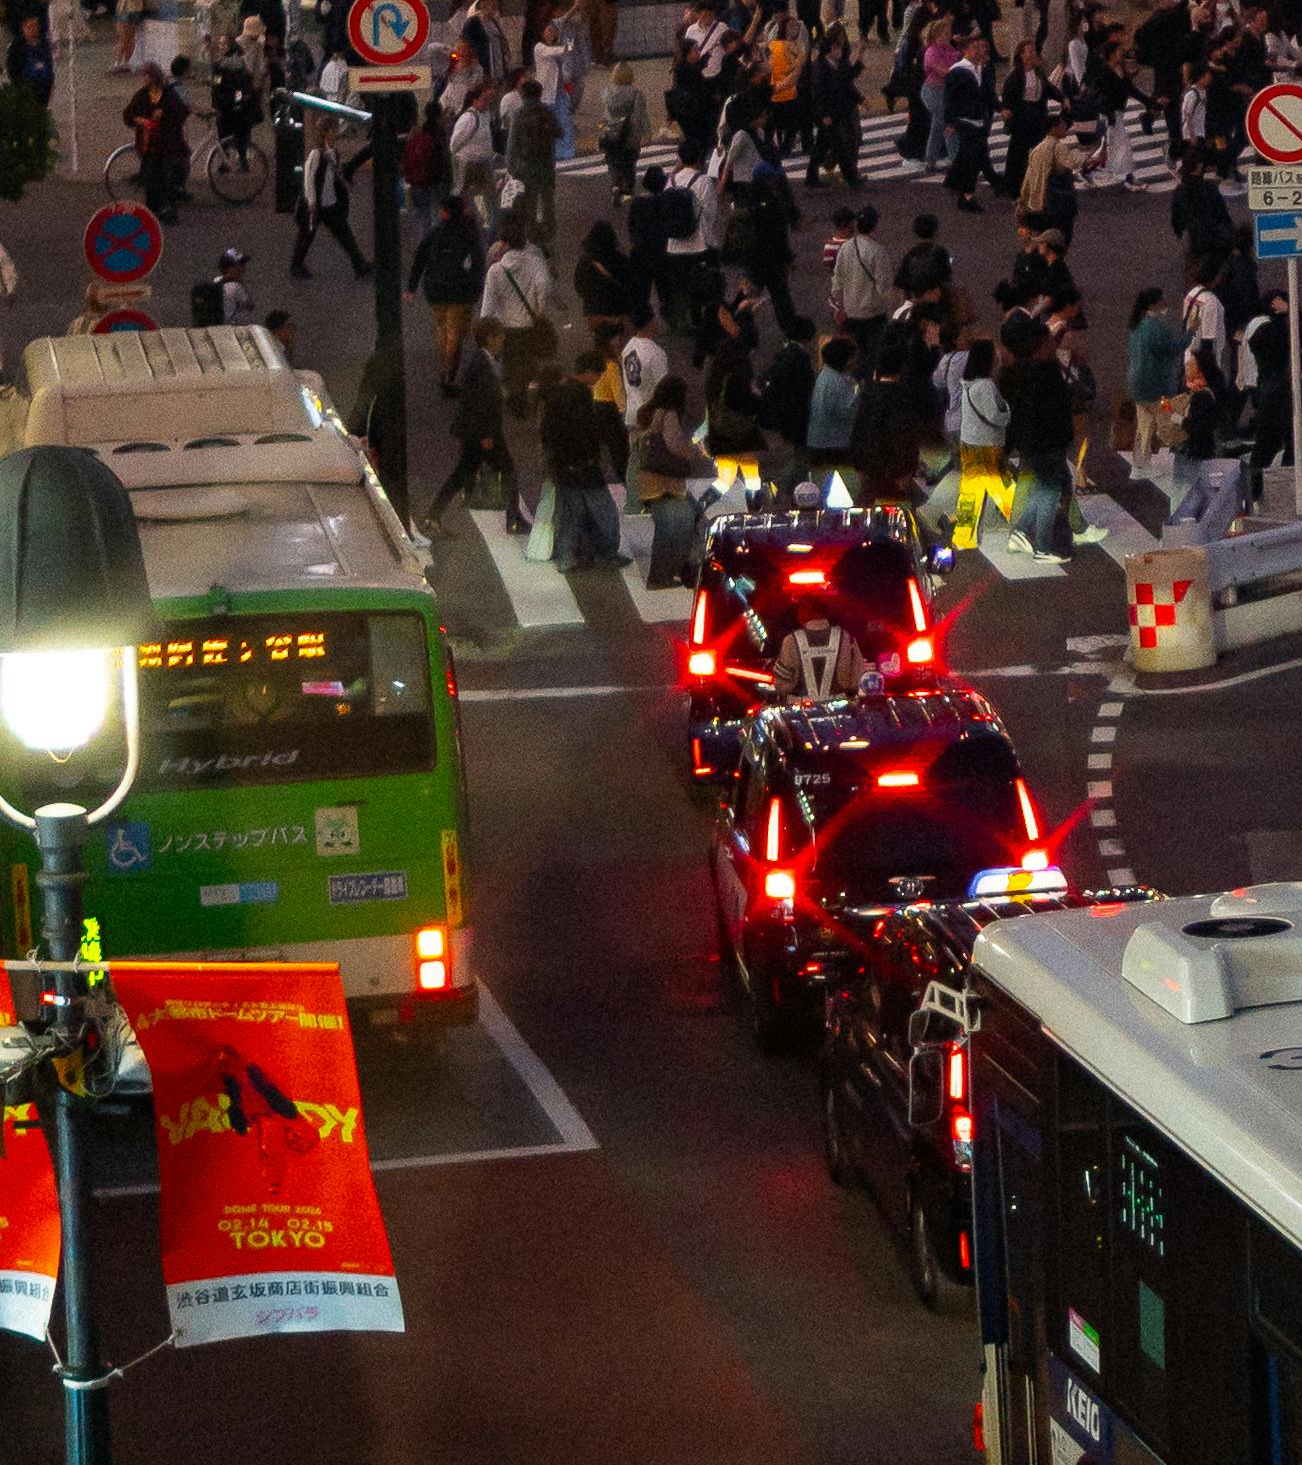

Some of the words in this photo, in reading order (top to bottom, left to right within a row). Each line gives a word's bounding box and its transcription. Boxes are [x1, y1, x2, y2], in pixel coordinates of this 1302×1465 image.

[160, 749, 299, 775] Hybrid
[159, 825, 307, 854] ノンステップバス
[230, 1230, 326, 1249] TOKYO
[177, 1280, 390, 1310] 渋谷道玄坂商店街振興組合
[1066, 1377, 1101, 1442] KEIO
